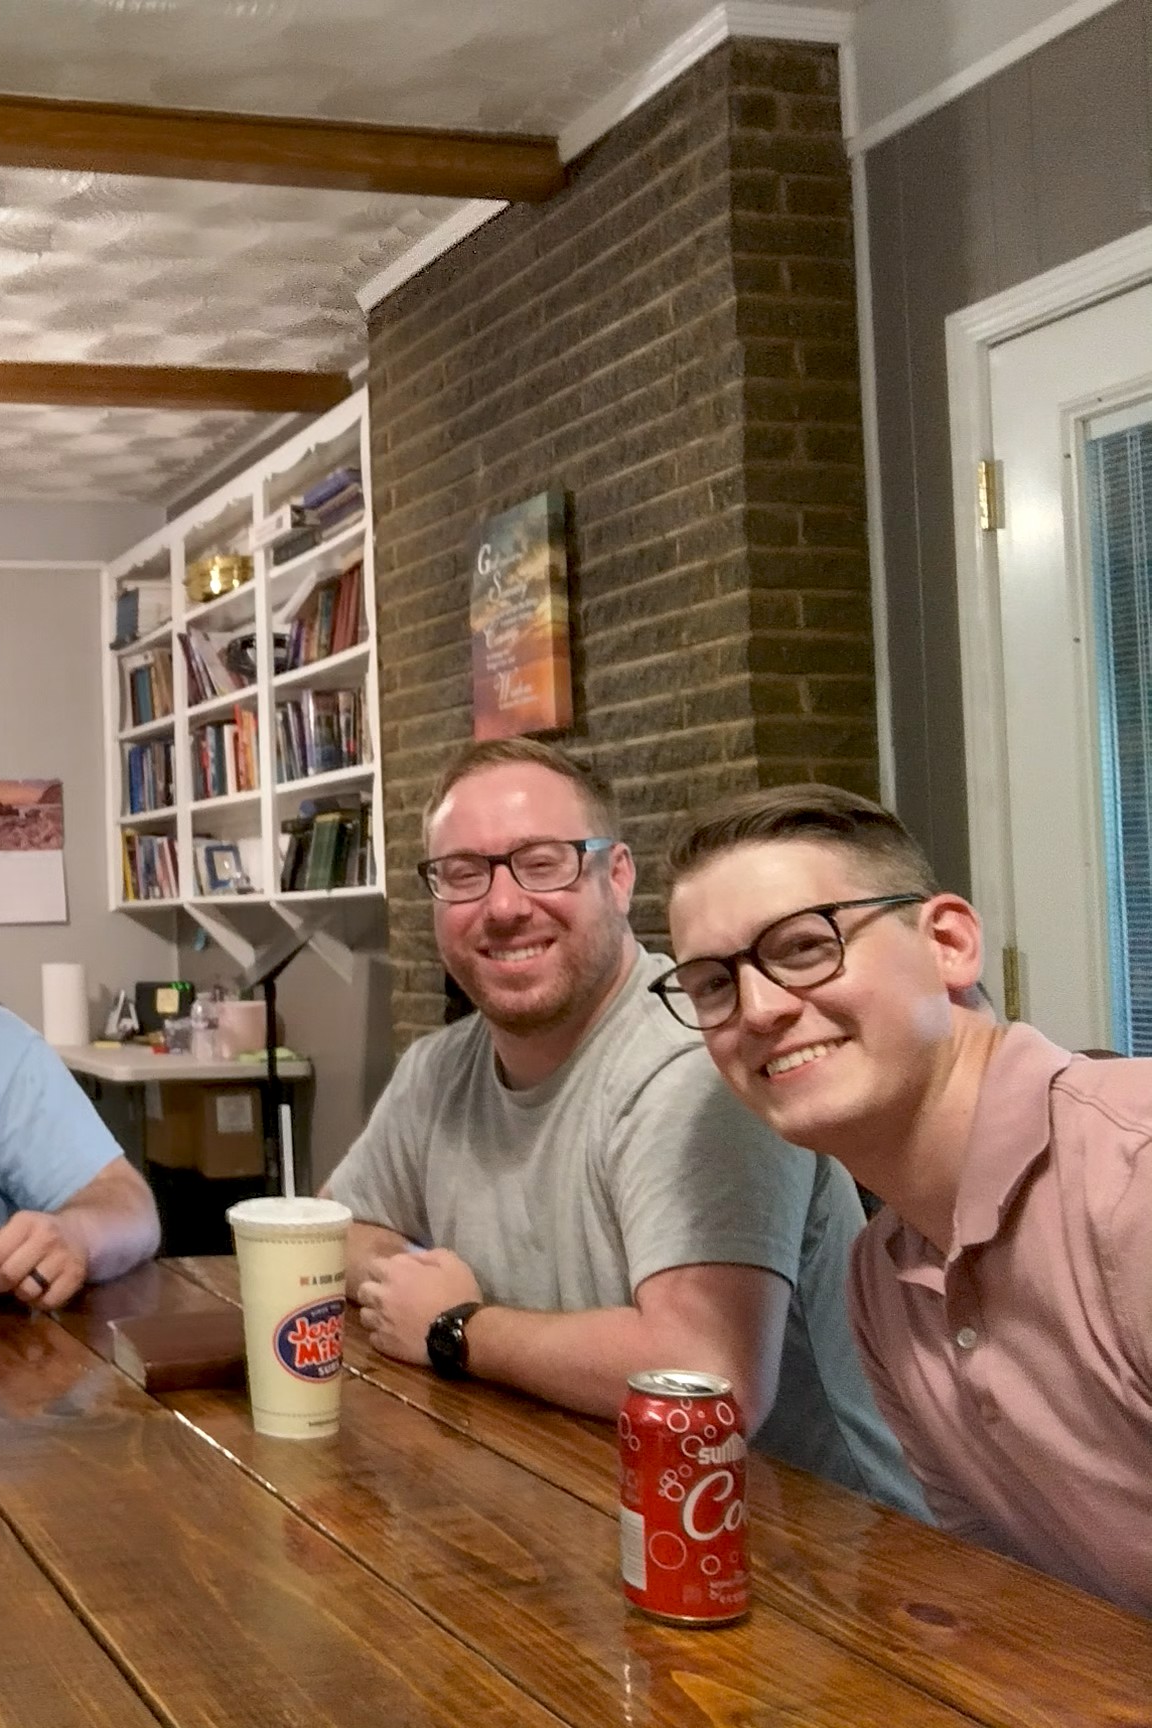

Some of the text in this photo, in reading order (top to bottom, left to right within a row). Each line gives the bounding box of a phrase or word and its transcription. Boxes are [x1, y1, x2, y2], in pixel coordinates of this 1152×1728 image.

[289, 1317, 343, 1343] Jers
[296, 1337, 342, 1366] Mik
[681, 1470, 748, 1541] Co
